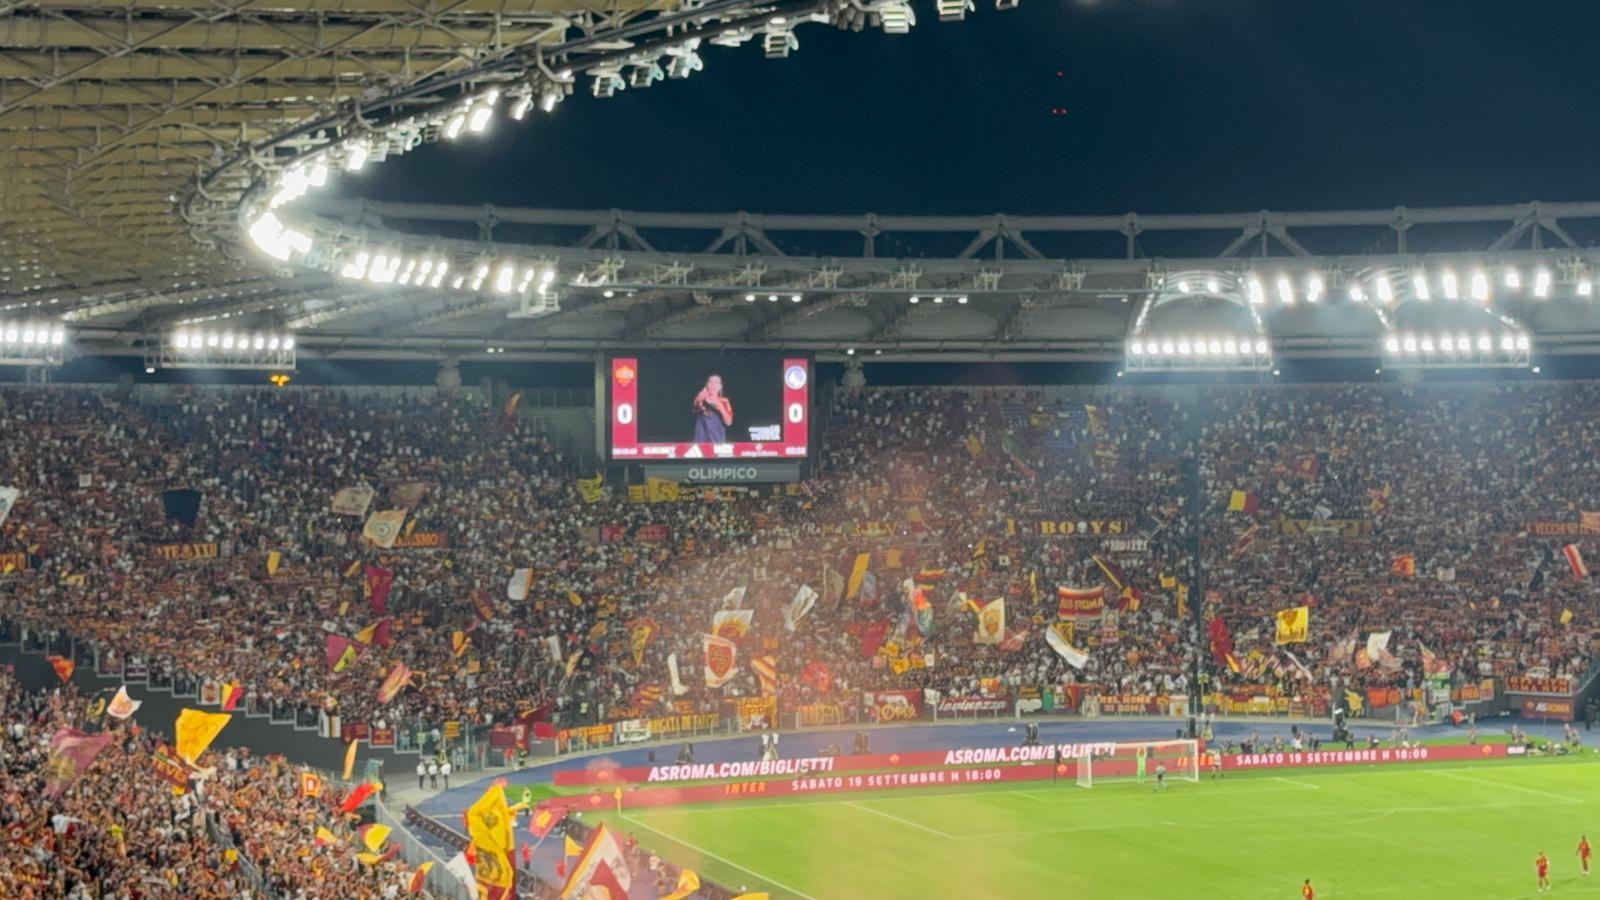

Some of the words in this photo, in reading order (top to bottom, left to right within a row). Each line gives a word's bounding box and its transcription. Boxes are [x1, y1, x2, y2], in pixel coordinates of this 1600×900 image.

[617, 403, 633, 424] 0
[788, 403, 803, 423] 0
[688, 467, 757, 480] OLIMPICO
[944, 742, 1116, 765] ASROMA.COM/BGLIETTI
[1236, 753, 1284, 766] SABATO
[1288, 752, 1302, 764] 19
[1306, 750, 1378, 763] SETTEMBRE
[1382, 749, 1390, 760] H
[1395, 748, 1428, 760] 18:00
[648, 757, 834, 781] ASROMA.COM/BIGLIETTI
[725, 782, 767, 794] INTER
[792, 777, 843, 791] SABATO
[849, 776, 863, 787] 19
[868, 771, 945, 786] SETTEMBRE
[951, 771, 960, 782] H
[965, 769, 1002, 781] 18:00
